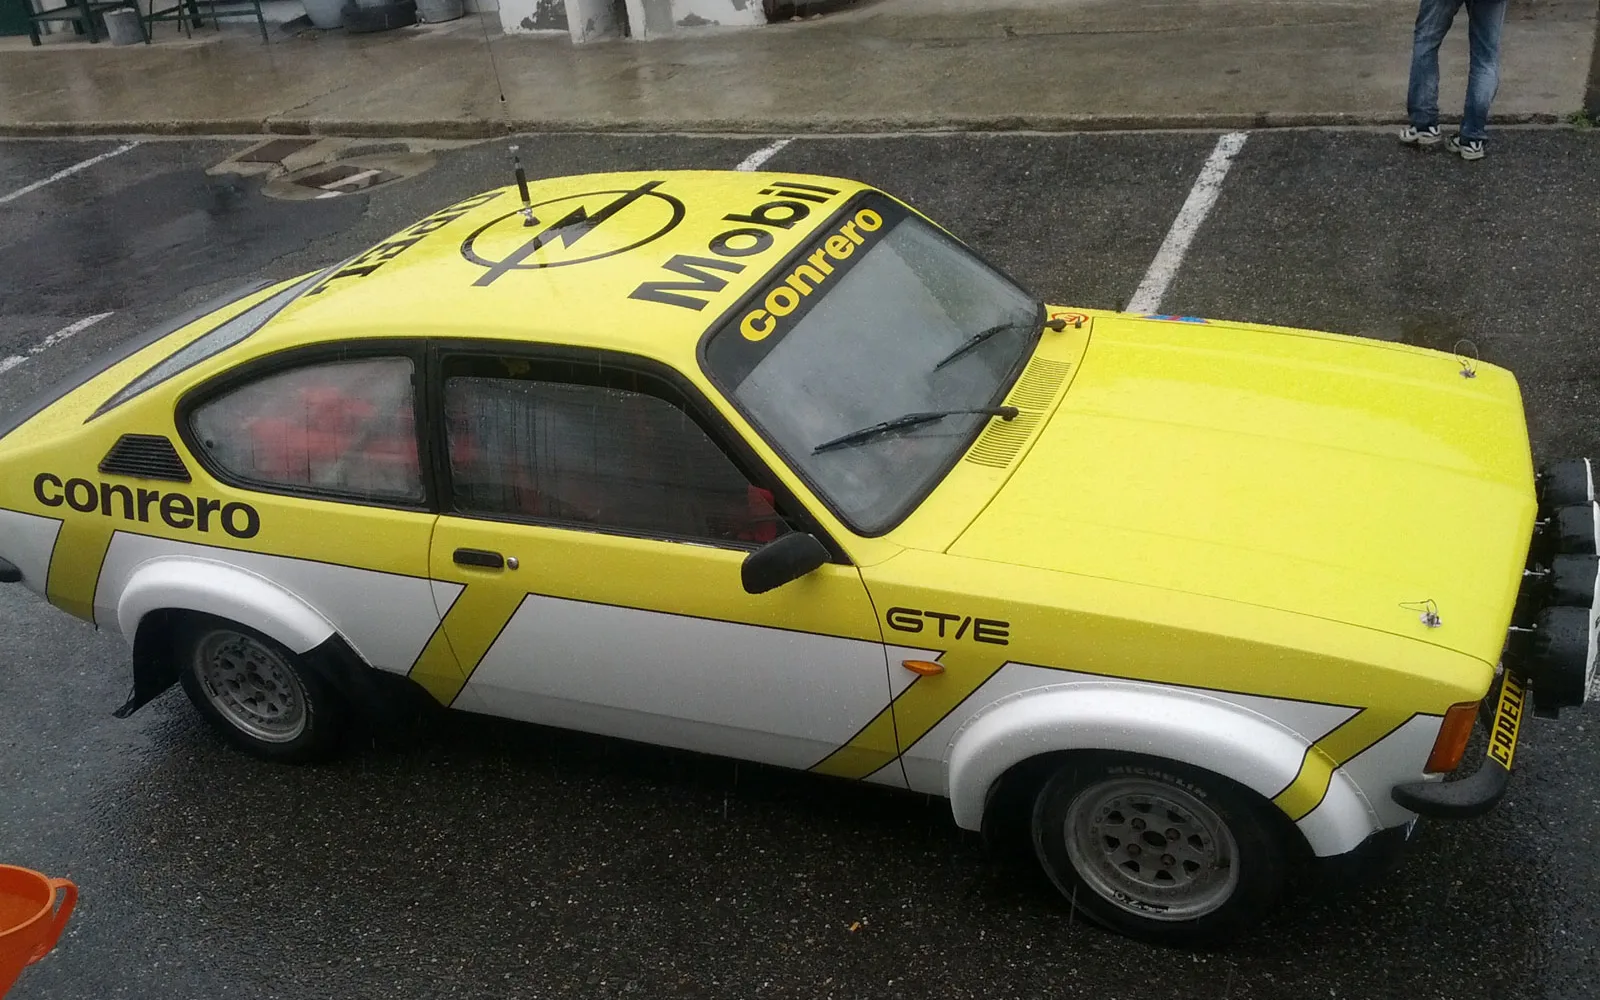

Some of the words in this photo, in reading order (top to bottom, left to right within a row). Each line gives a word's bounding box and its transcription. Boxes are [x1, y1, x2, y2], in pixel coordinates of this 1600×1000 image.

[627, 181, 841, 312] Mobil
[739, 208, 883, 342] conrero
[33, 472, 260, 539] conrero
[886, 606, 1010, 646] GT/E
